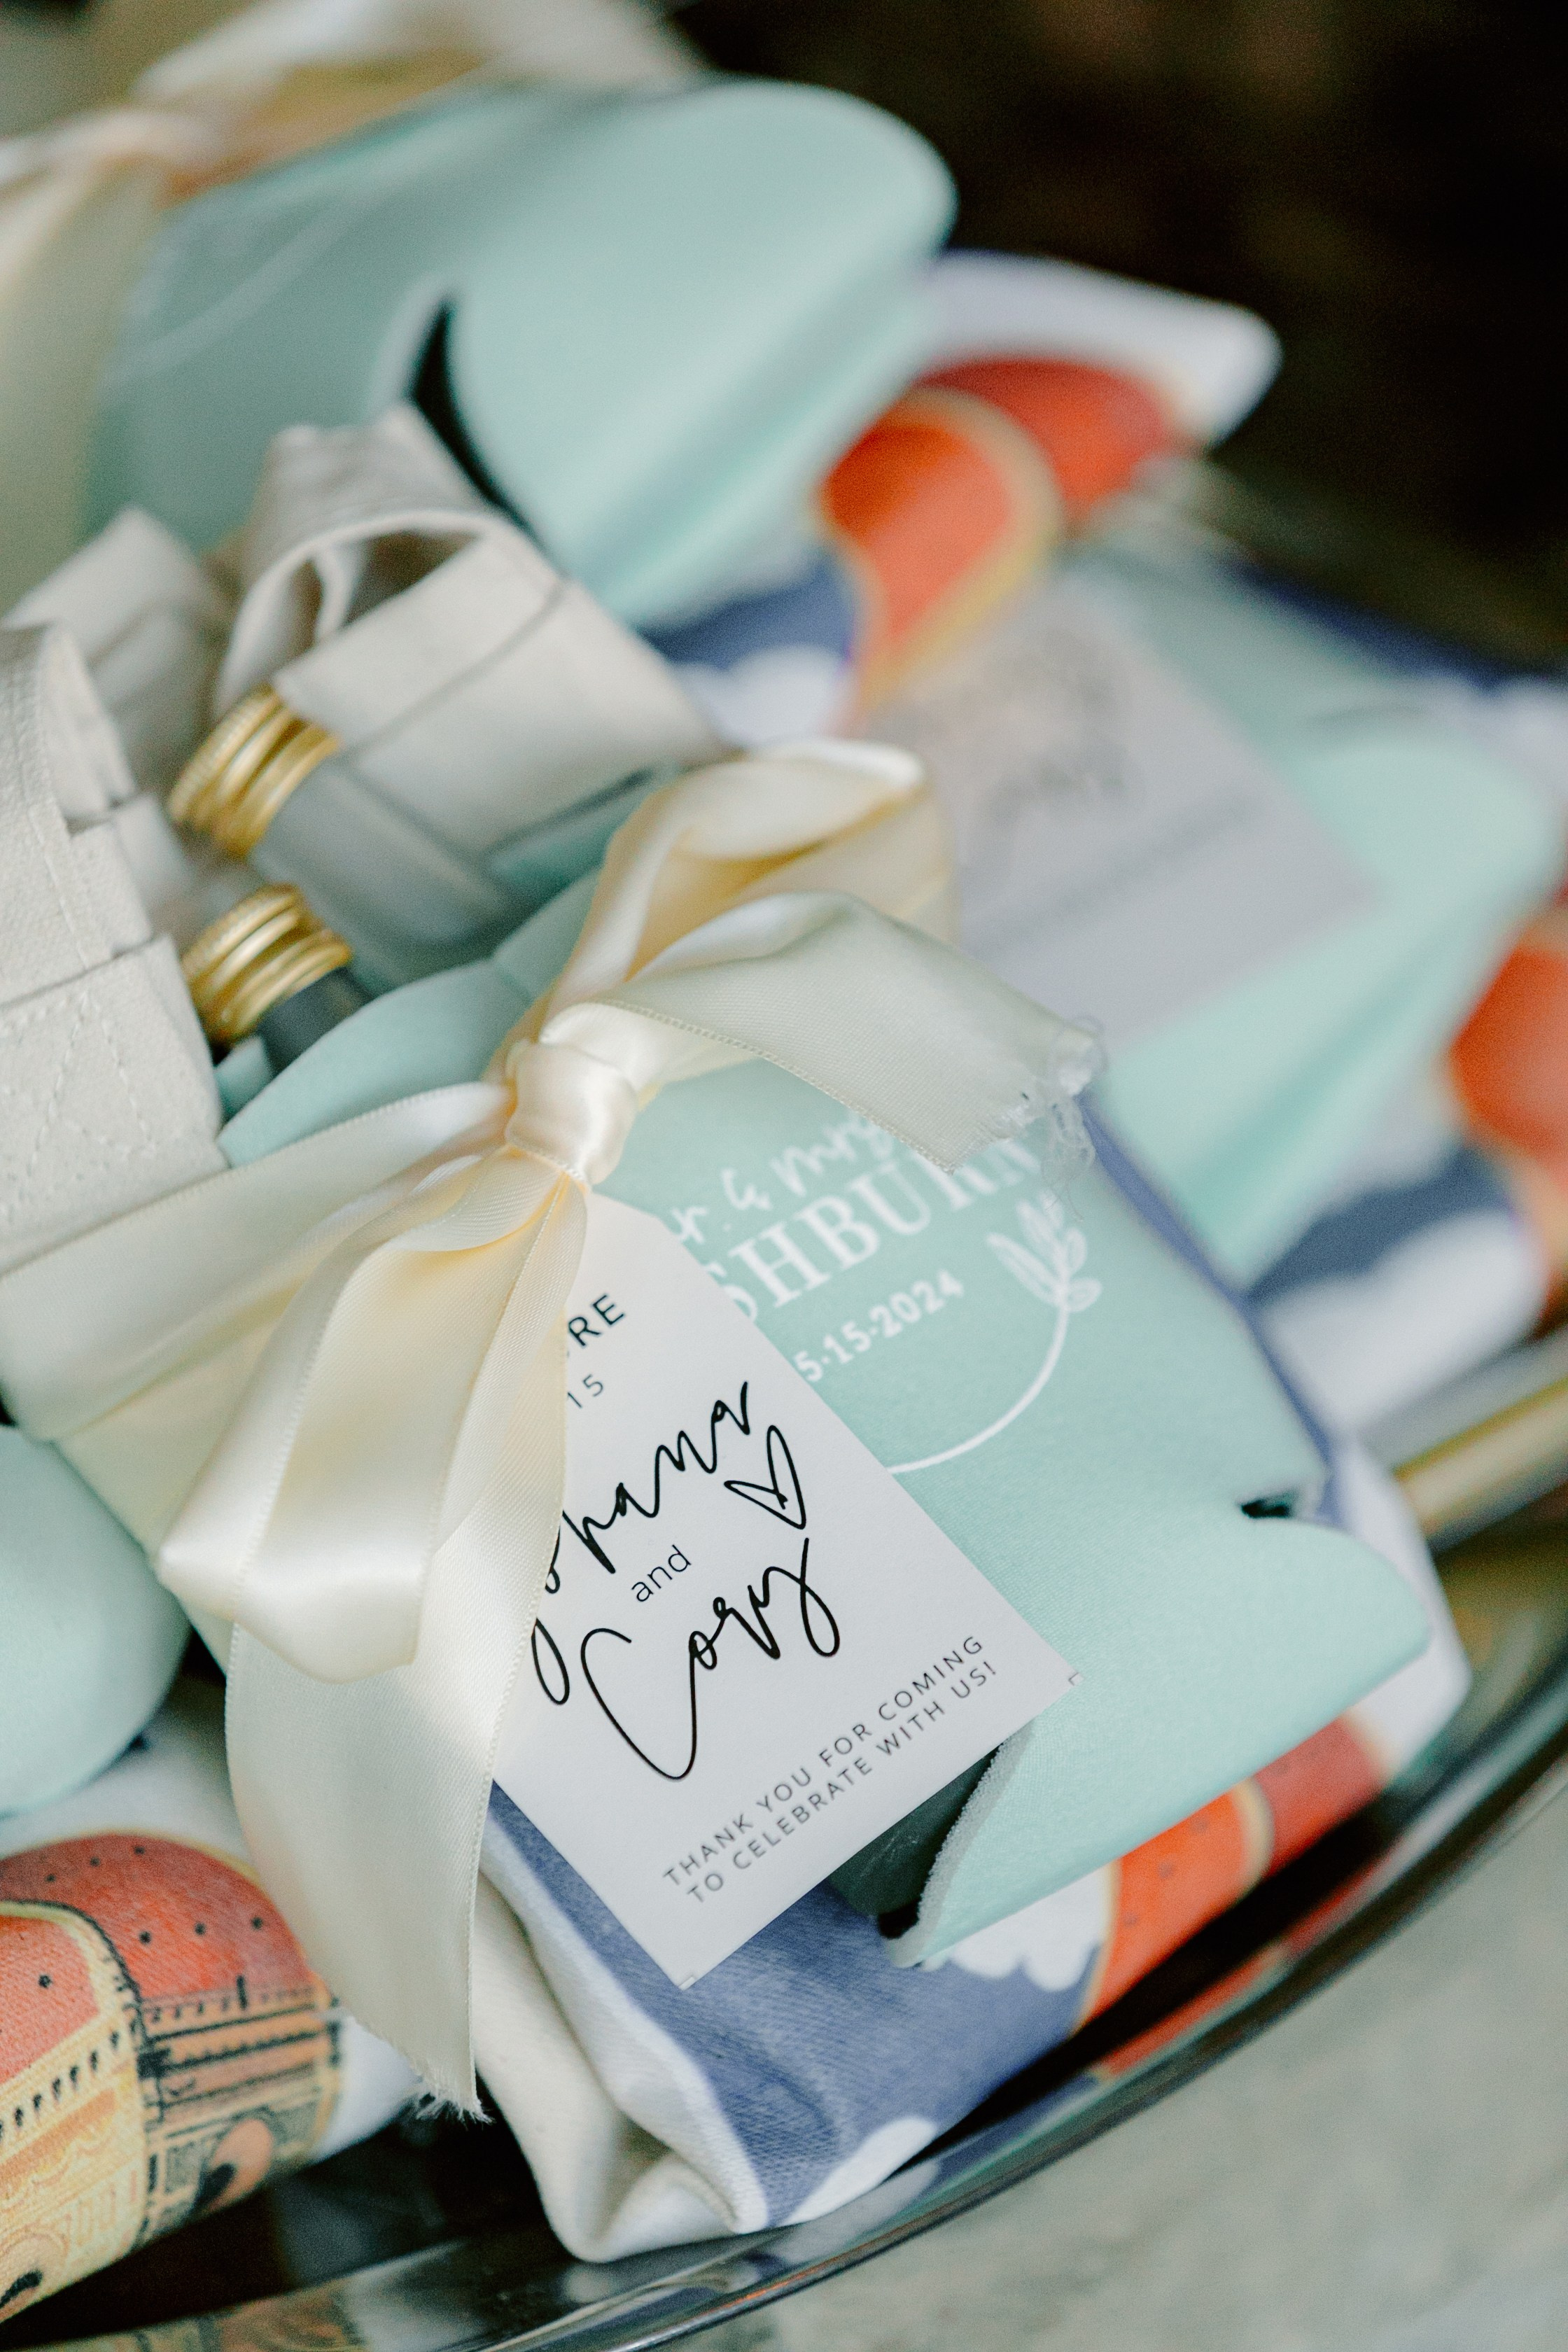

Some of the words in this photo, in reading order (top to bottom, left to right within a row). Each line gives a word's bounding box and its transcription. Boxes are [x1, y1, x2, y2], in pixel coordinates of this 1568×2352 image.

[580, 1537, 841, 1782] Cory
[631, 1544, 693, 1602] and
[662, 1813, 754, 1886] THANK
[755, 1767, 812, 1814] YOU
[818, 1723, 873, 1768] FOR
[878, 1635, 983, 1722] COMING
[687, 1872, 724, 1903] TO
[732, 1756, 873, 1870] CELEBRATE
[875, 1700, 945, 1757] WITH
[950, 1660, 997, 1699] US!
